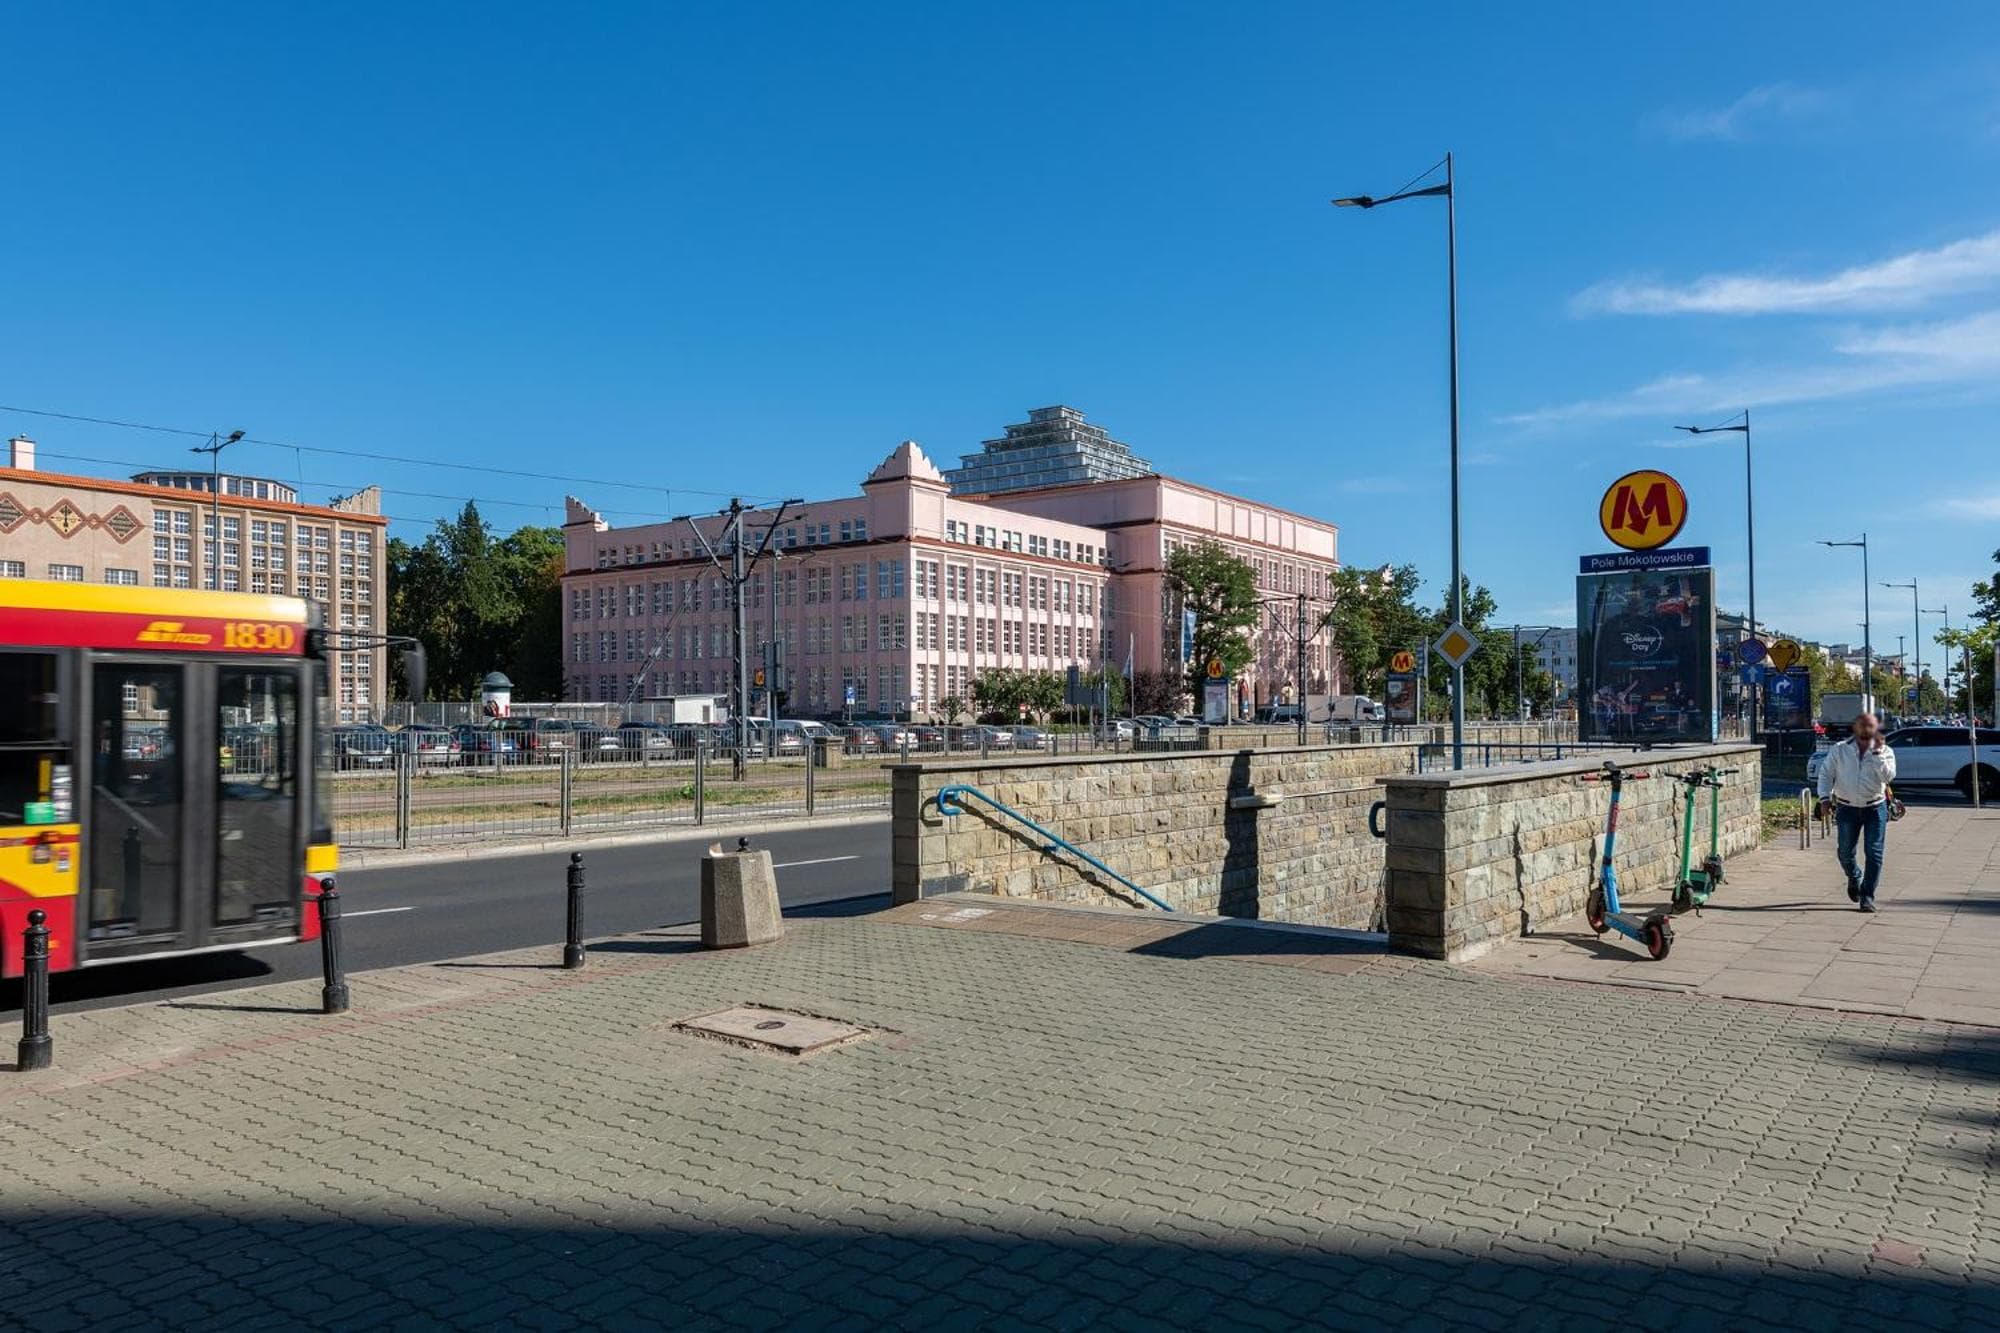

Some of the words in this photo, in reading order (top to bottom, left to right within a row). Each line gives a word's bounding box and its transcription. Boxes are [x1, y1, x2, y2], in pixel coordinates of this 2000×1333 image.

[1611, 483, 1672, 535] M
[1591, 557, 1615, 568] Pole
[1618, 552, 1694, 566] Mokotowskie
[223, 622, 295, 649] 1830
[1621, 633, 1656, 645] Disney
[1631, 643, 1650, 652] Day
